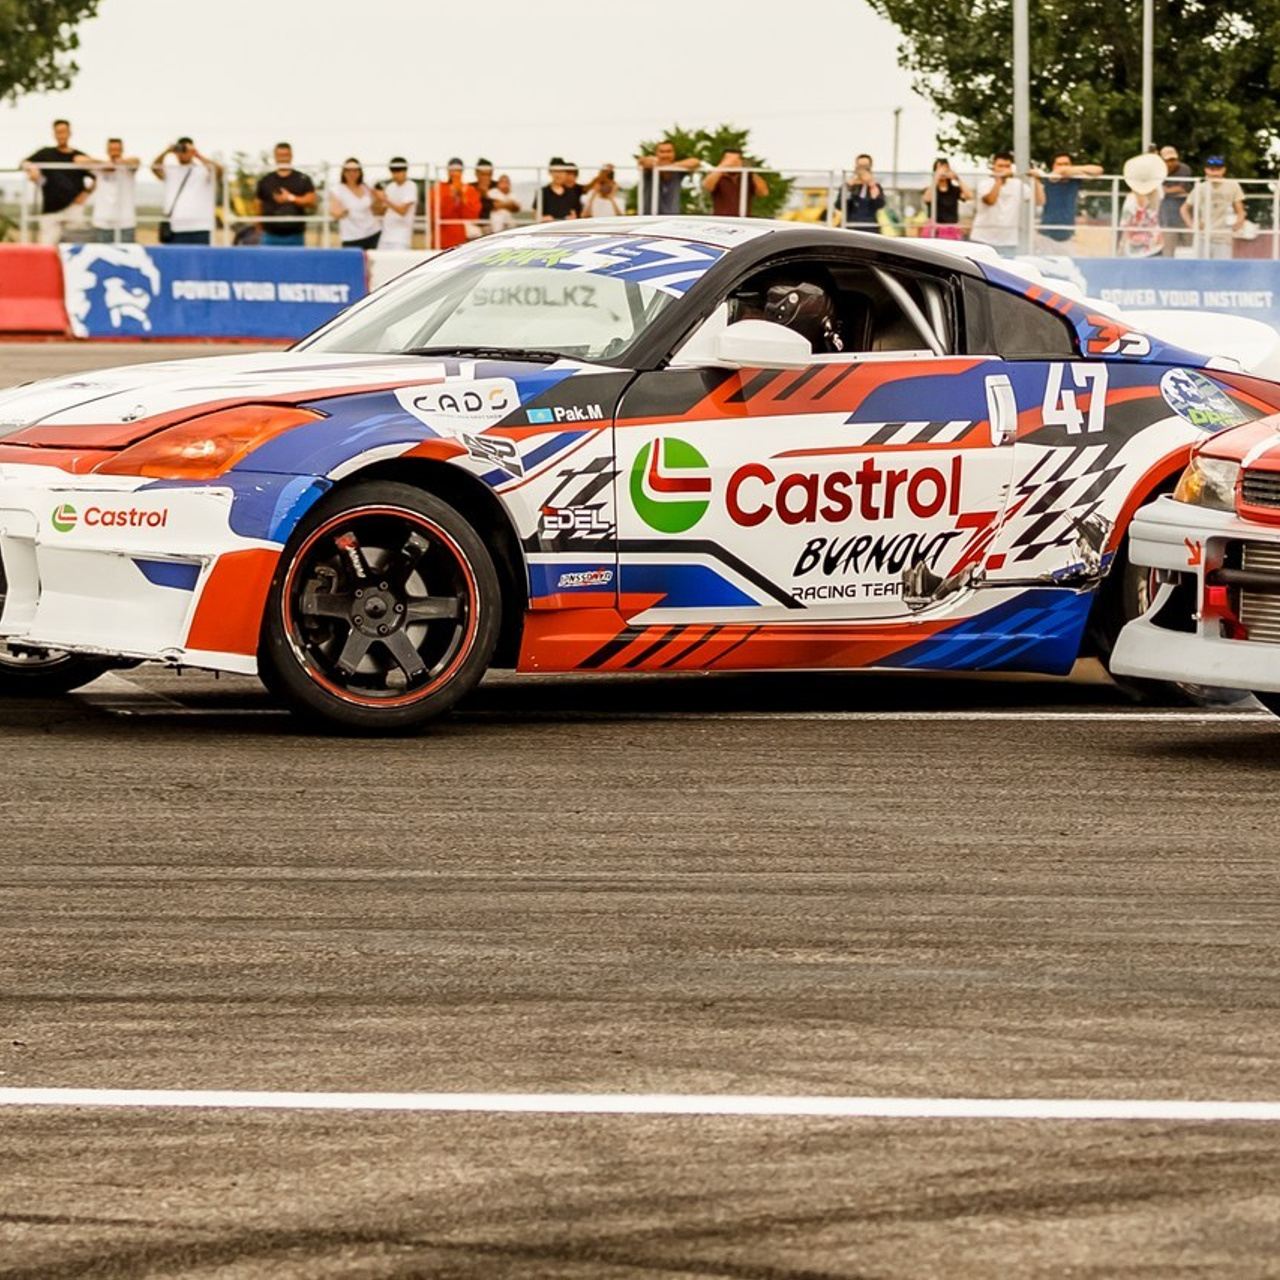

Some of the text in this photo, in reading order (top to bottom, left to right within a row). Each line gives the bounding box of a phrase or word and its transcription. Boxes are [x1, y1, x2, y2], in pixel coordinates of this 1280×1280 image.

[171, 280, 350, 304] POWER YOUR INSTINCT
[1100, 288, 1274, 308] POWER YOUR INSTINCT
[1041, 361, 1109, 435] 47
[553, 404, 604, 422] Pak.M
[725, 454, 963, 527] Castrol
[84, 506, 168, 527] Castrol
[792, 530, 965, 577] BURNOUT
[791, 584, 857, 600] RACING
